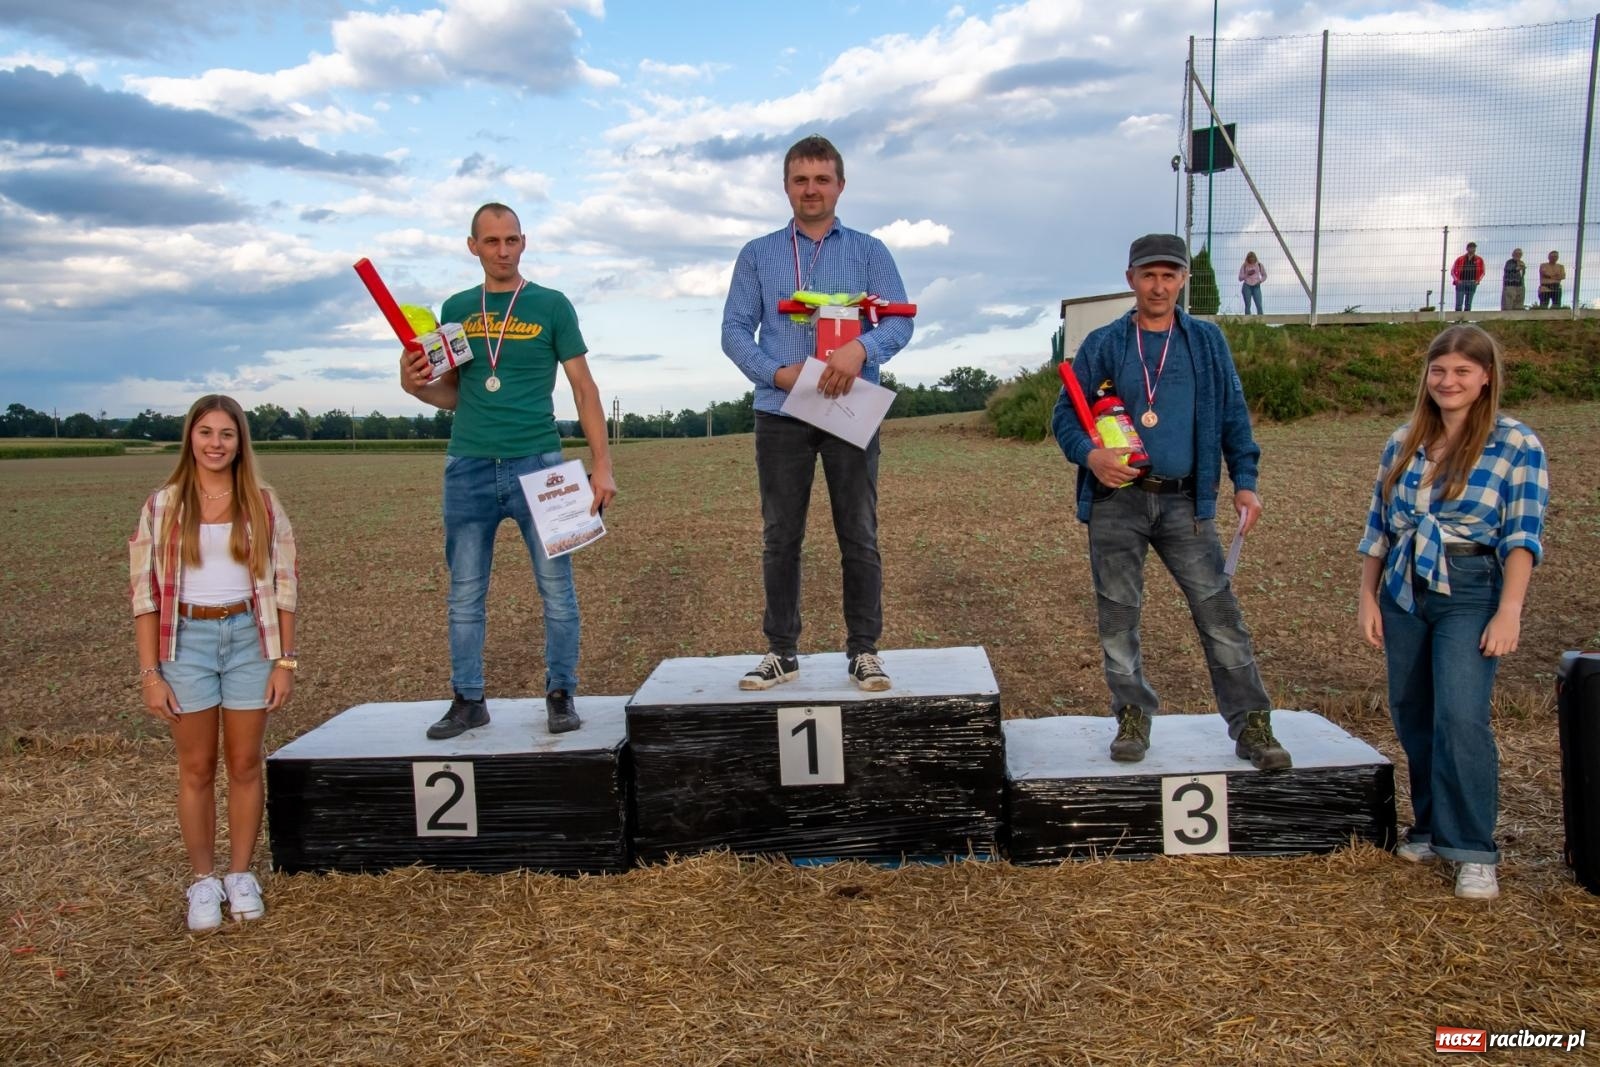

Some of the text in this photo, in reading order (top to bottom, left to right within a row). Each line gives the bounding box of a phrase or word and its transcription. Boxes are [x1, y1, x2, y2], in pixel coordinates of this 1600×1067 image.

[791, 719, 819, 775] 1
[425, 771, 468, 831] 2
[1172, 783, 1218, 845] 3
